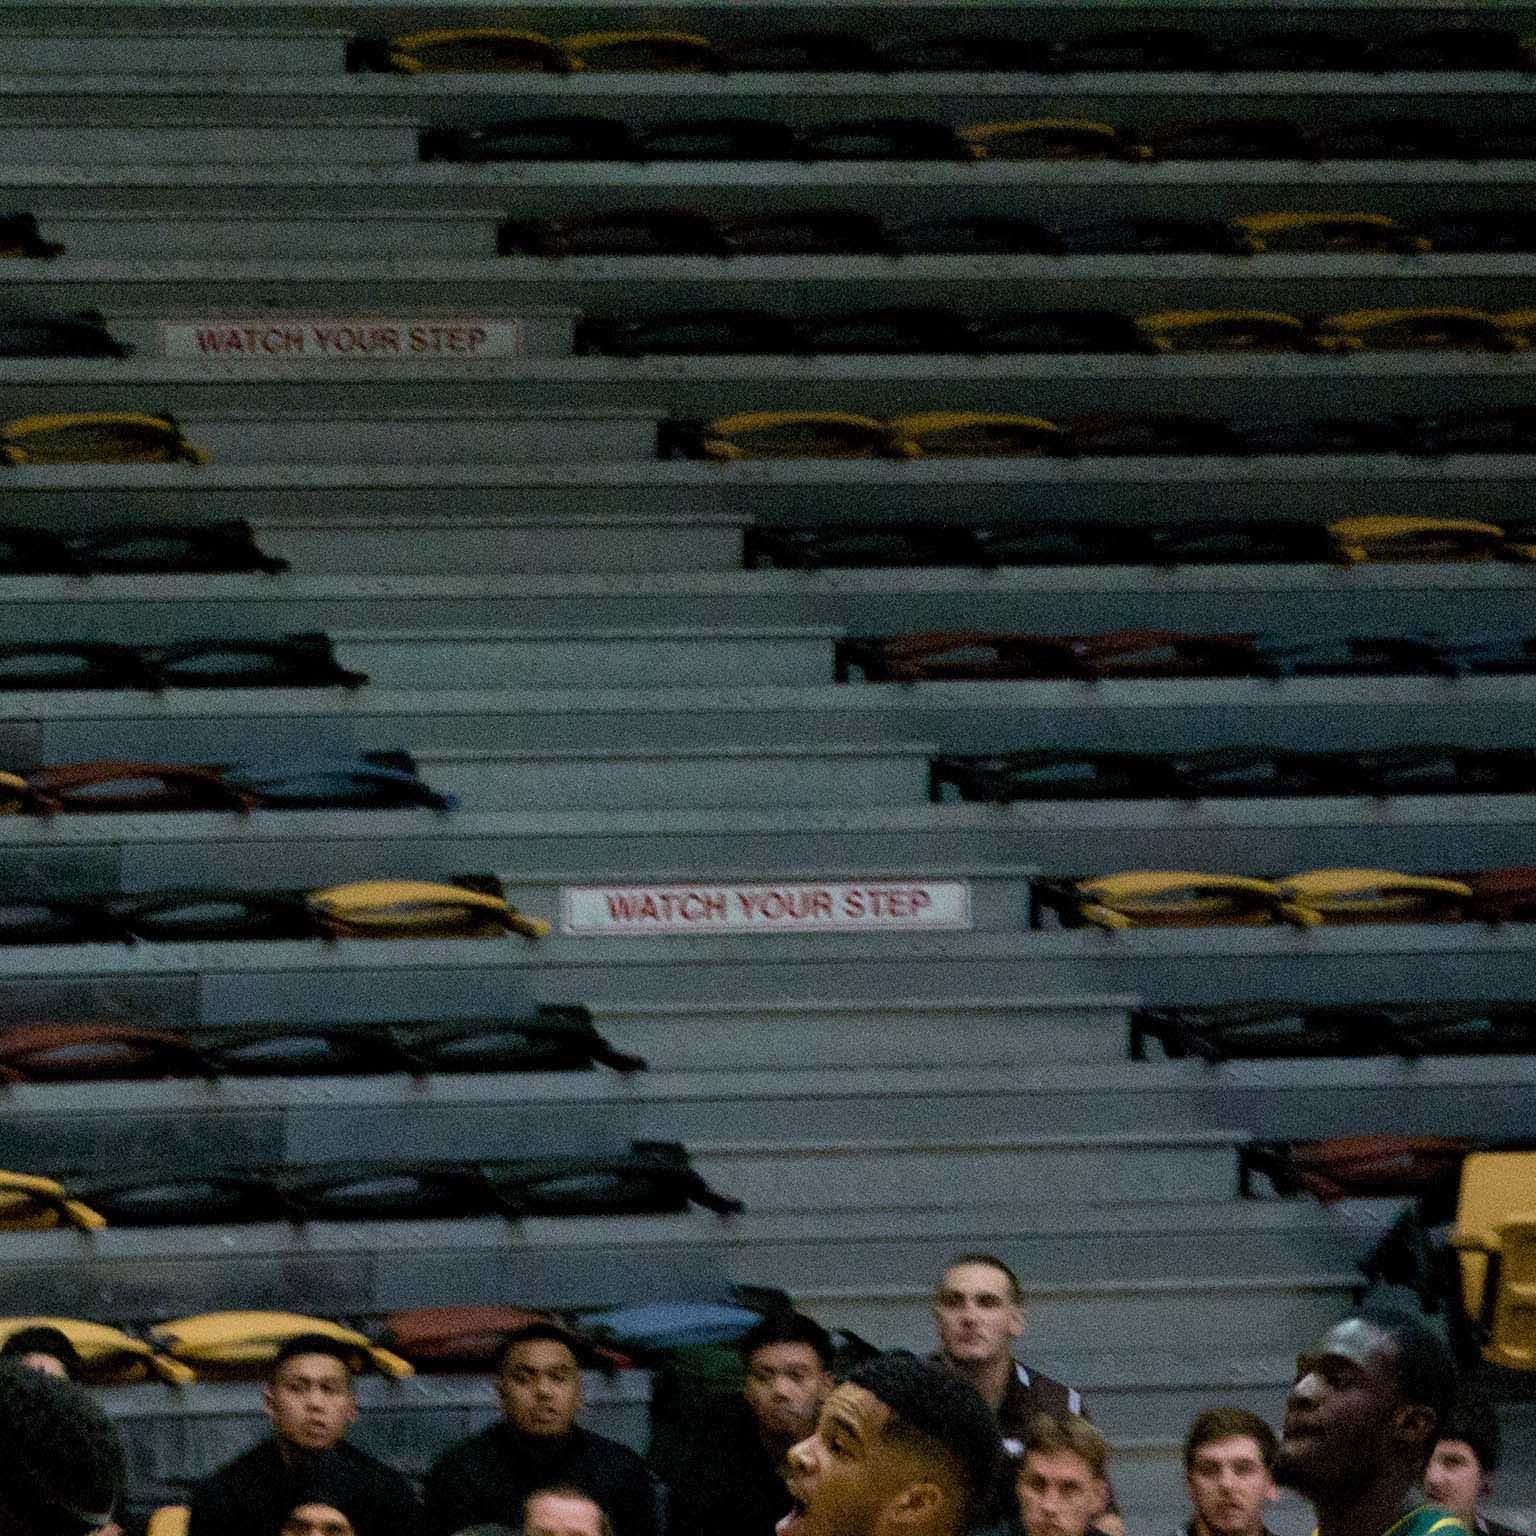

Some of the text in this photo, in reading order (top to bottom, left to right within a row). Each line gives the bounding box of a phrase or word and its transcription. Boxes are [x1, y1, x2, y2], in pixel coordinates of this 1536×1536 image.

[196, 326, 489, 354] WATCH YOUR STEP
[606, 889, 929, 923] WATCH YOUR STEP
